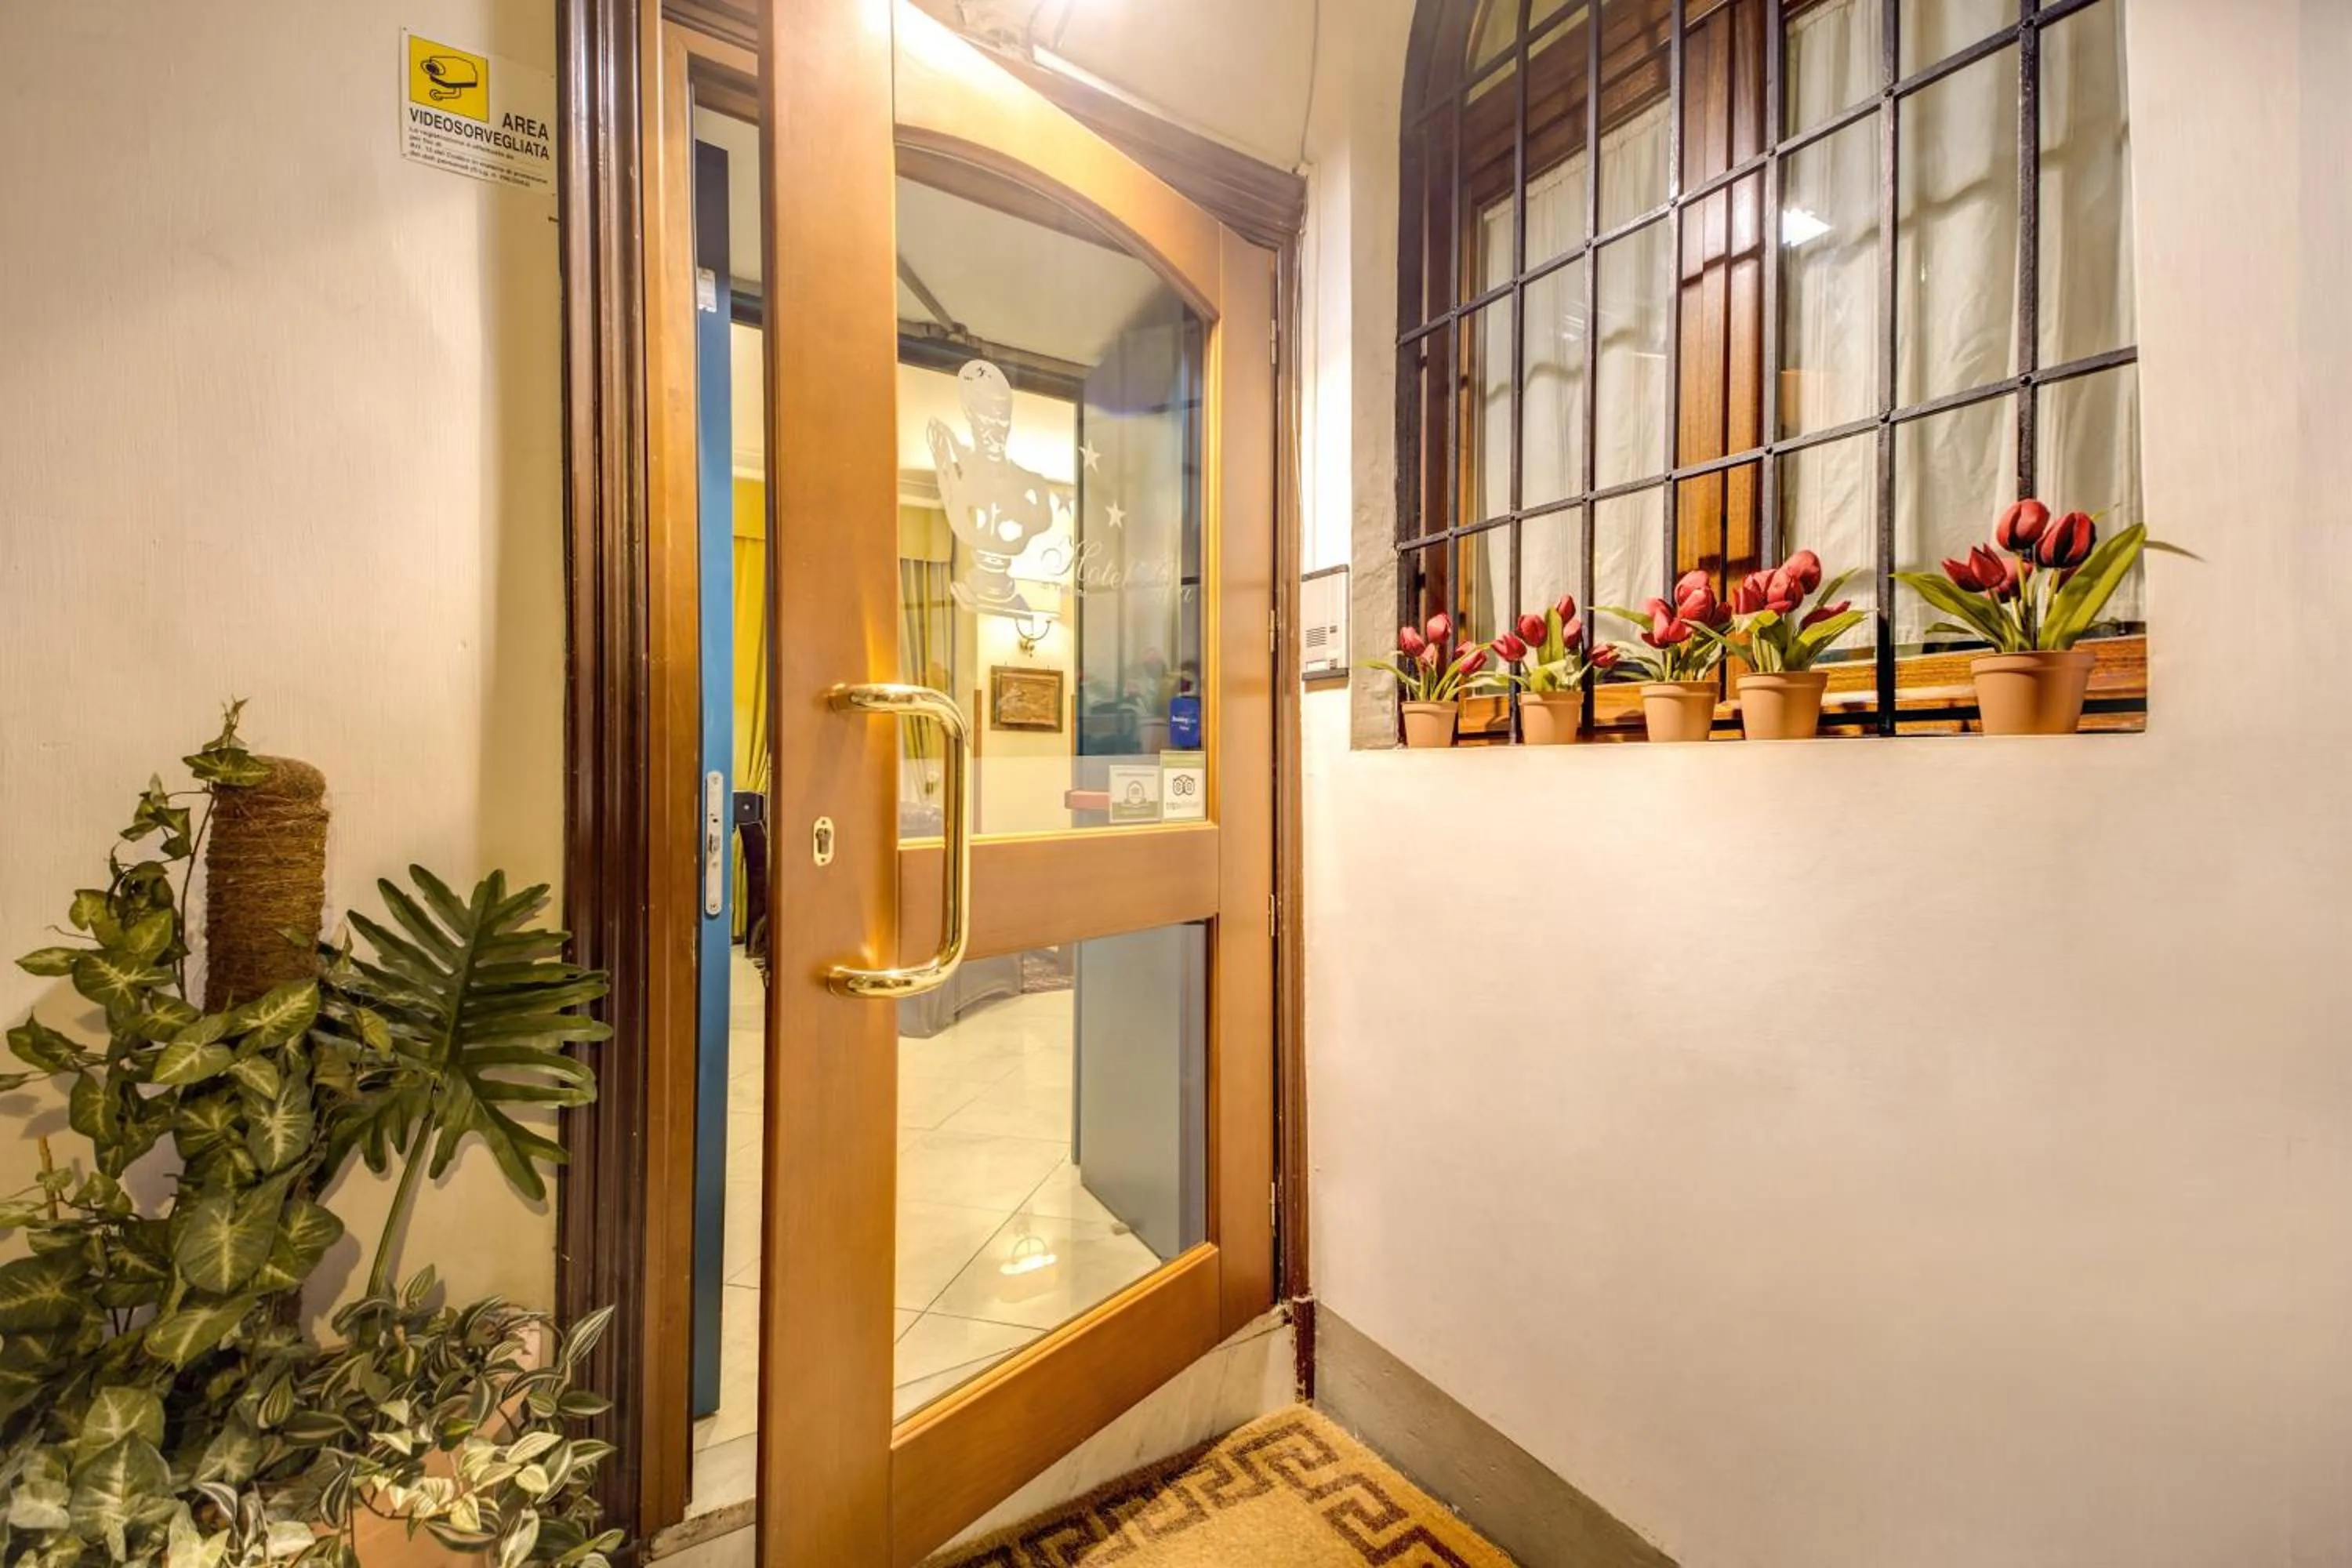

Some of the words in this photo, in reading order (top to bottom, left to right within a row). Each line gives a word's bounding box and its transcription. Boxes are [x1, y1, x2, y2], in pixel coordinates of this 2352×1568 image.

[409, 107, 550, 160] VIDEOSORVEGLIATA
[502, 112, 549, 141] AREA
[1040, 535, 1136, 590] Hotel
